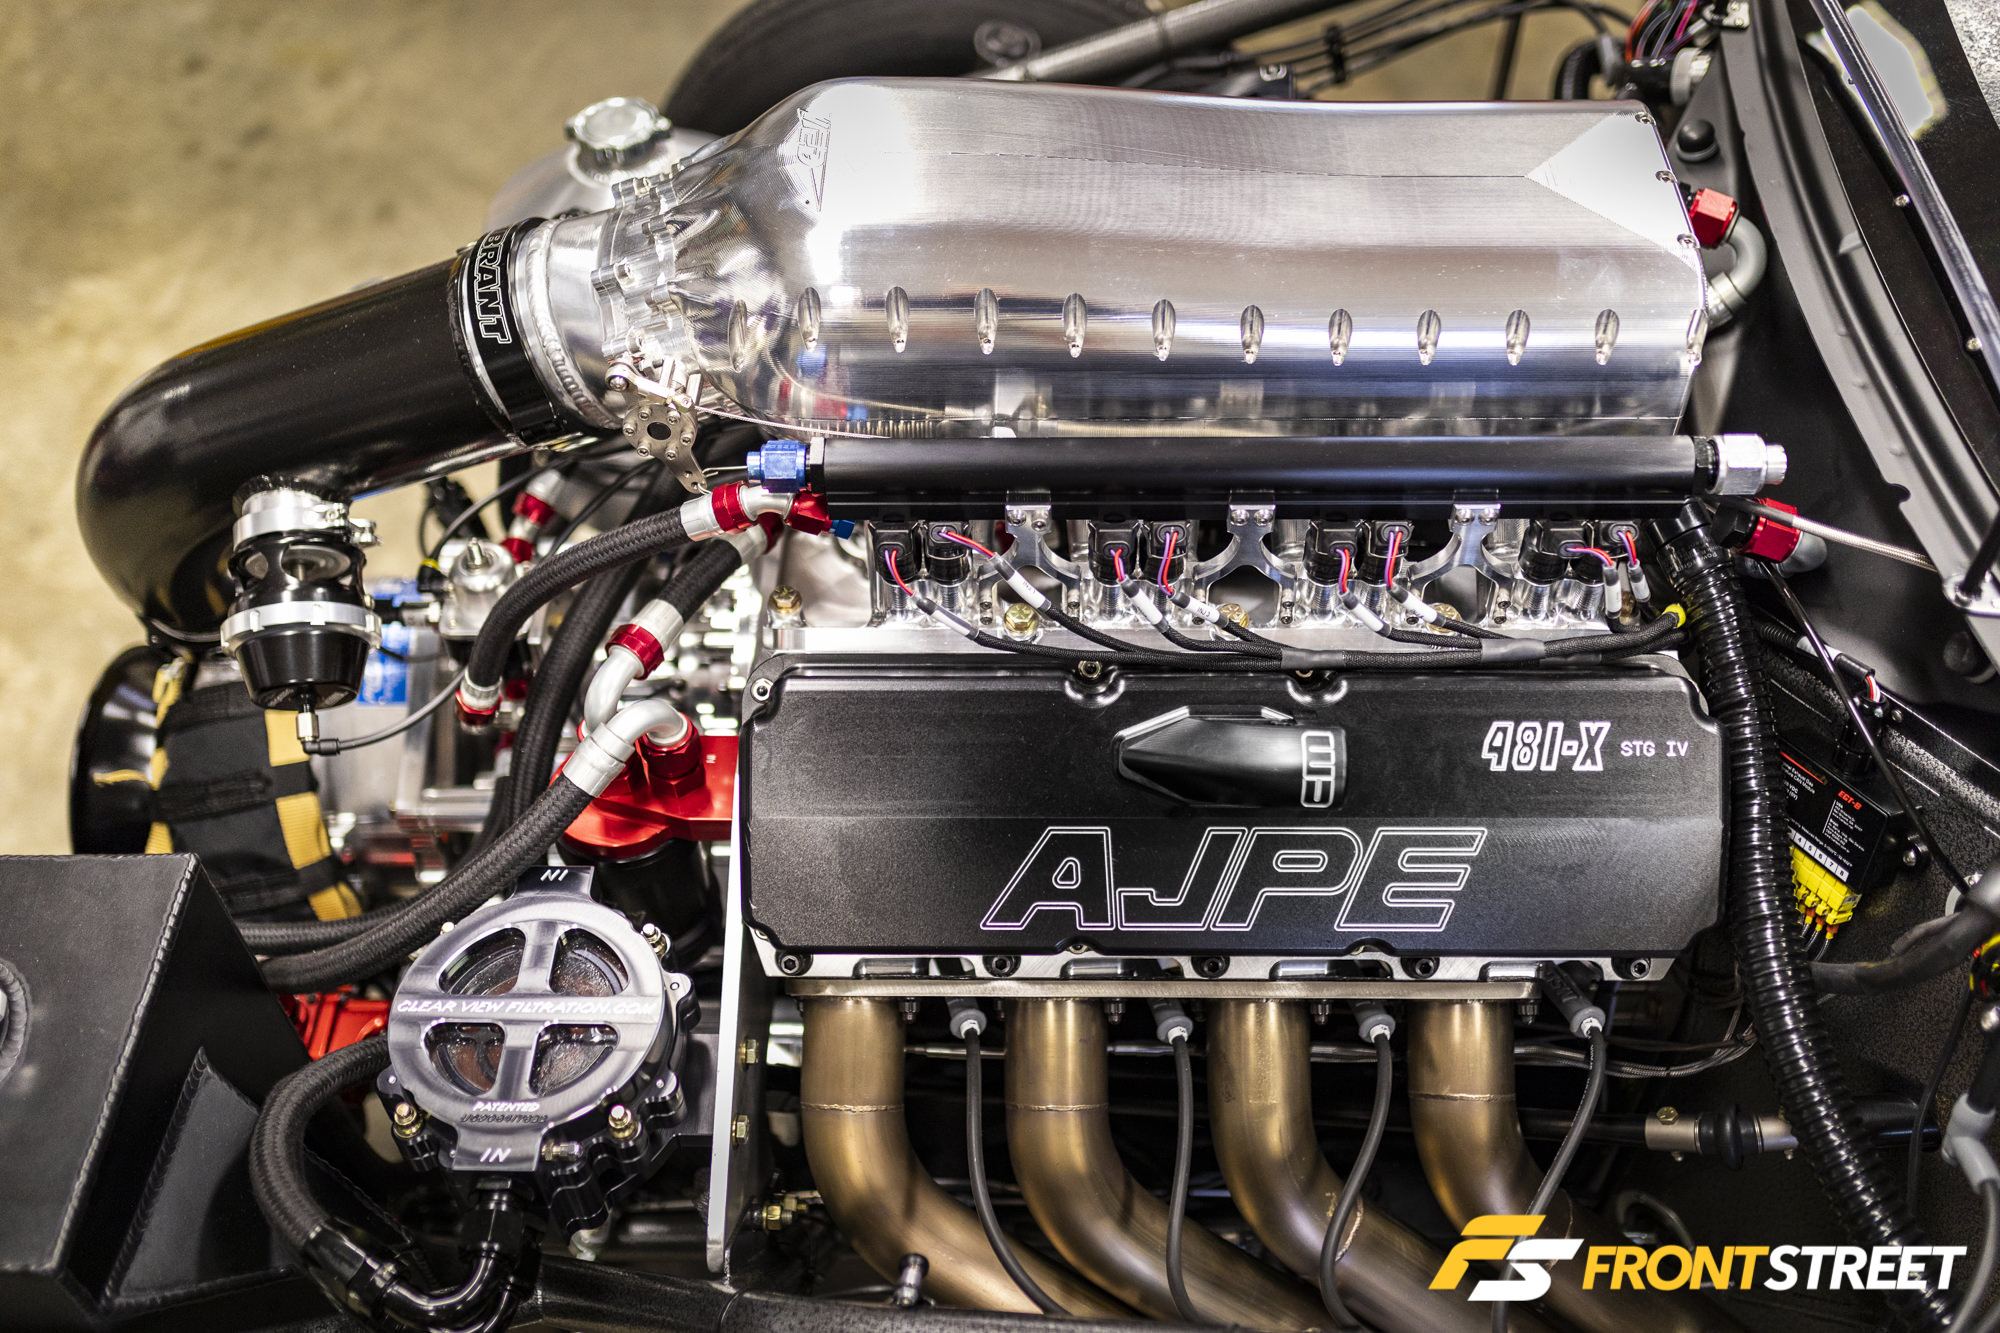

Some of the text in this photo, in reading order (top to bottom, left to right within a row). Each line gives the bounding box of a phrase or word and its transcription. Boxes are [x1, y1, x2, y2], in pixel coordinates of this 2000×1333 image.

[1481, 720, 1689, 771] 481-X STG IV
[540, 868, 568, 882] IN
[980, 826, 1488, 932] AJPE
[397, 1000, 658, 1015] CLEAR VIEW FILTRATION.COM
[472, 1101, 541, 1112] PATENTED
[480, 1147, 512, 1162] IN
